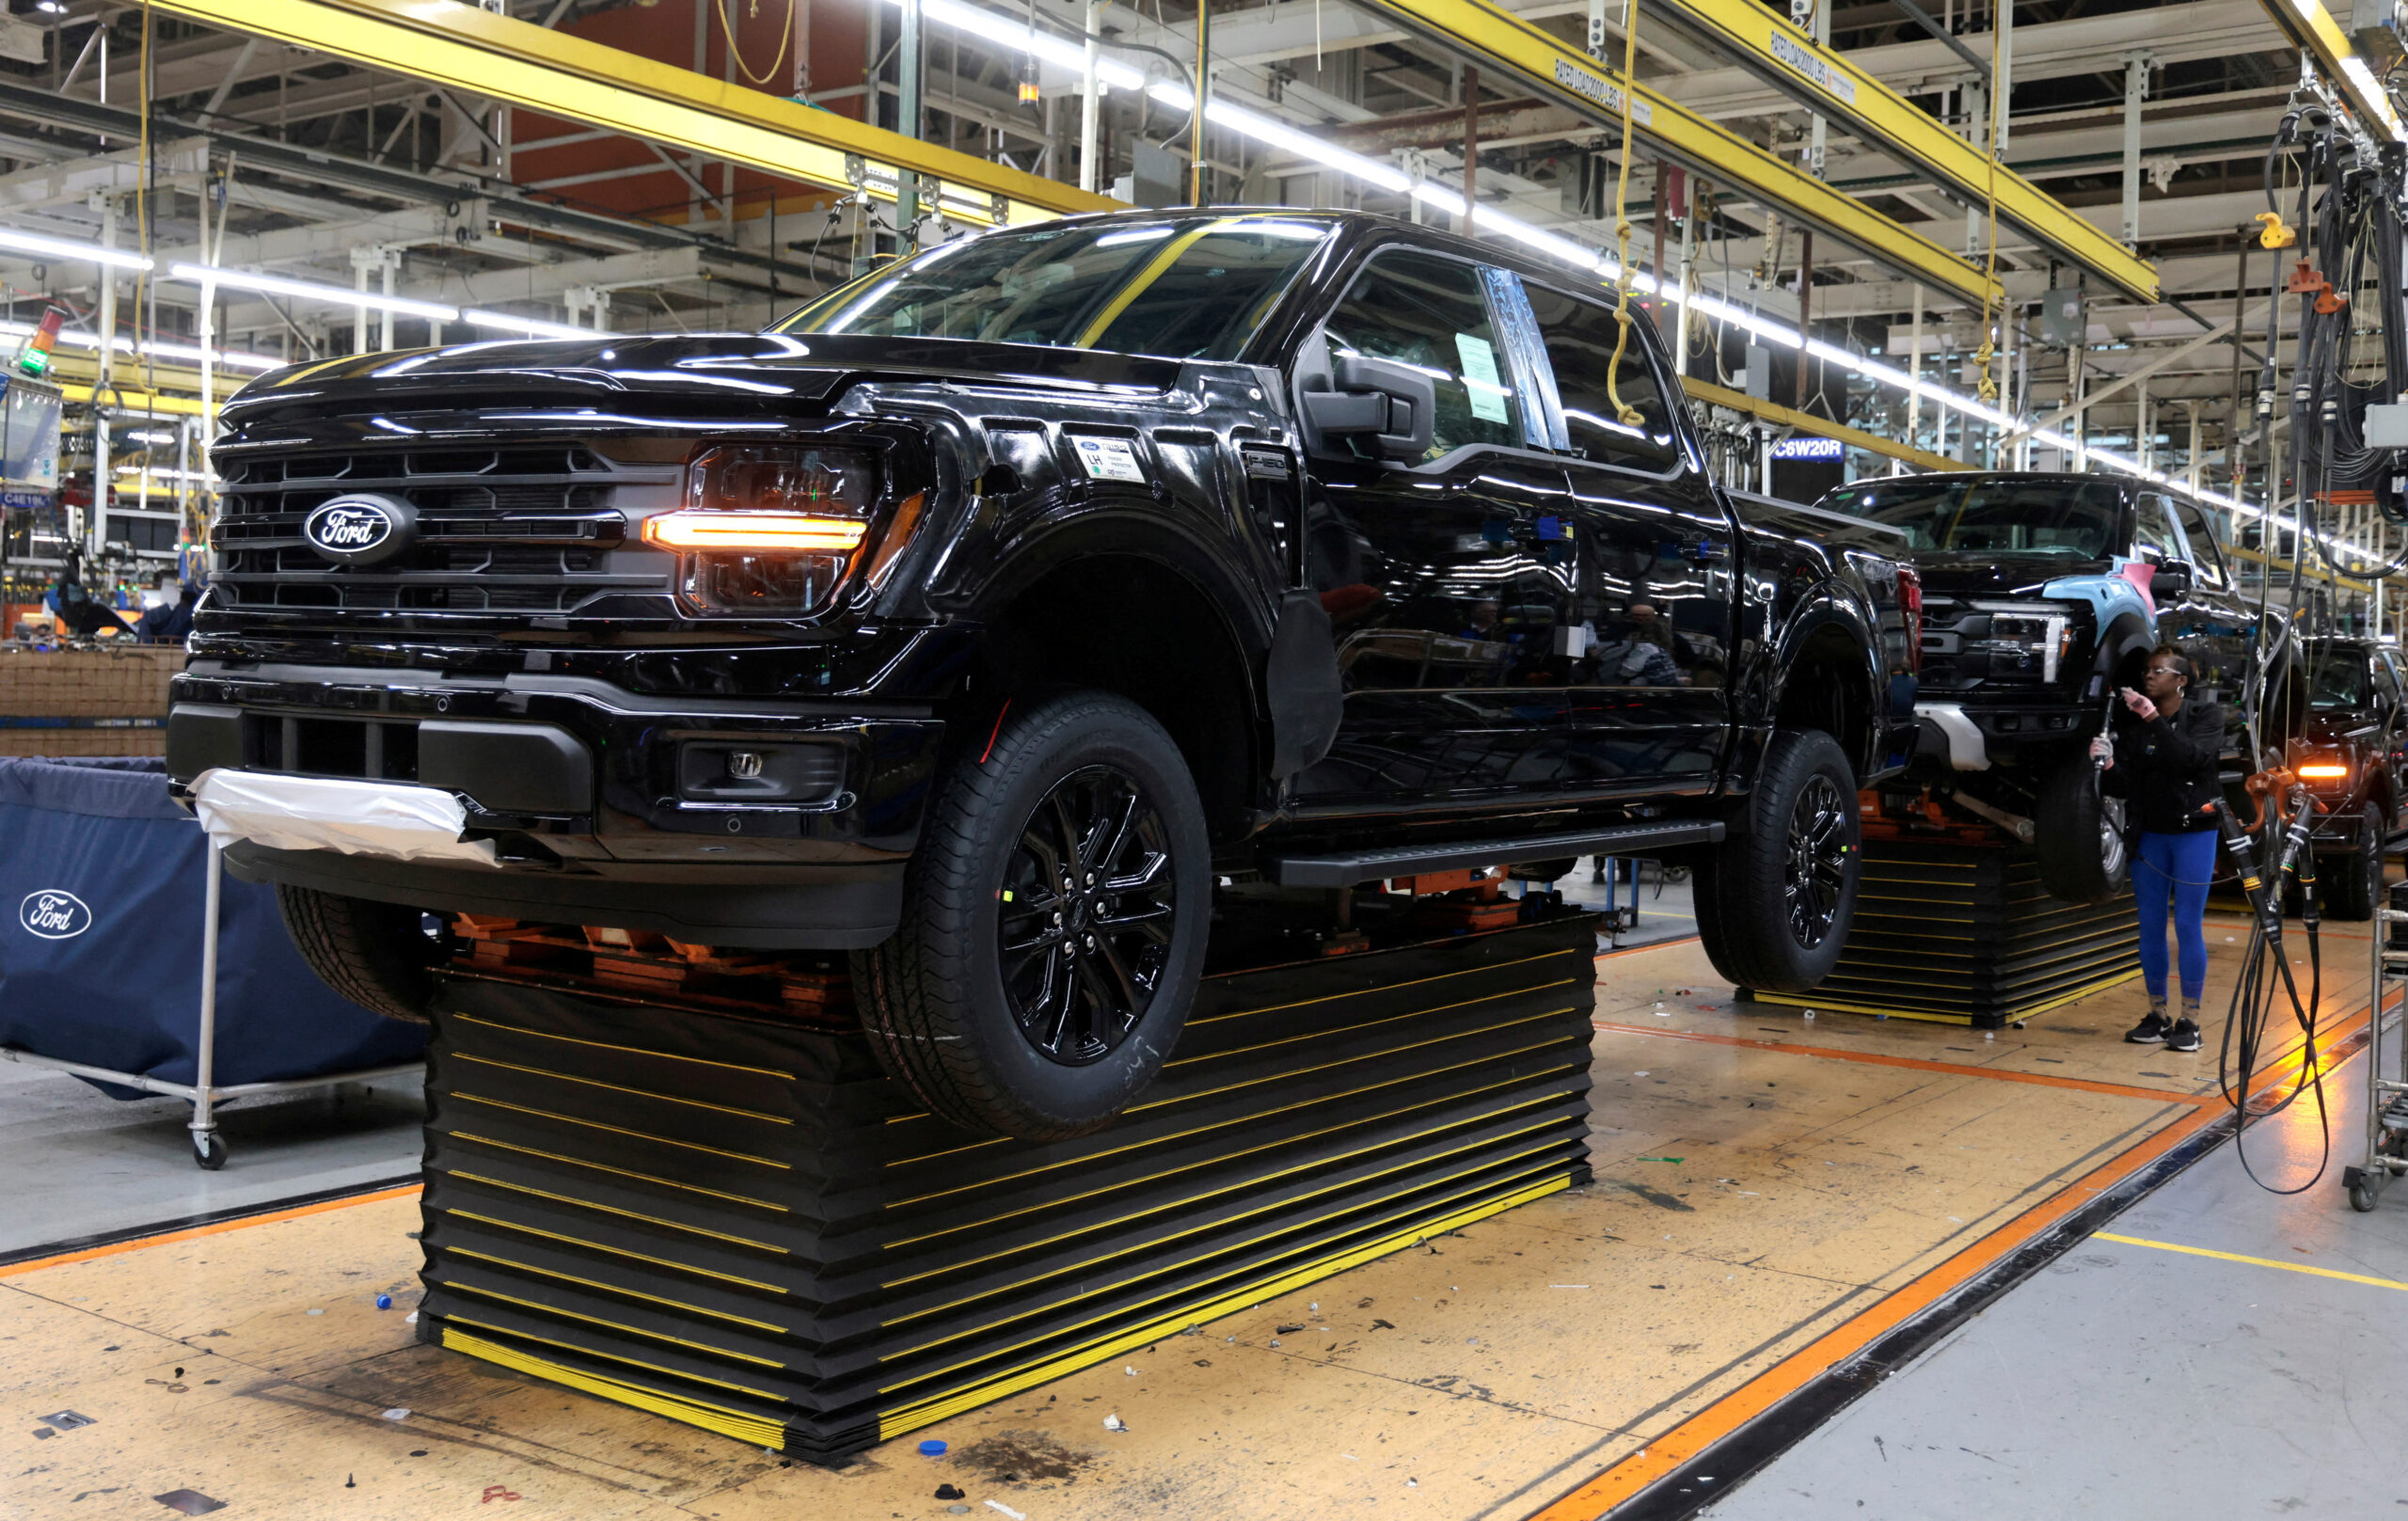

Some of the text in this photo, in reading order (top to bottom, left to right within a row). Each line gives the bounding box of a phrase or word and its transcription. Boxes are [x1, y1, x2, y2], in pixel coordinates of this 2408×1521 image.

[1771, 29, 1787, 60] RATED
[1787, 40, 1800, 70] LOAD
[1800, 49, 1814, 77] 2000
[1556, 58, 1574, 87] RATED
[1574, 67, 1590, 95] LOAD
[1590, 75, 1605, 103] 2000
[1086, 454, 1103, 466] LH
[1248, 454, 1286, 469] F-150
[1774, 439, 1842, 457] C6W20R
[322, 509, 375, 544] Ford
[30, 895, 74, 930] Ford
